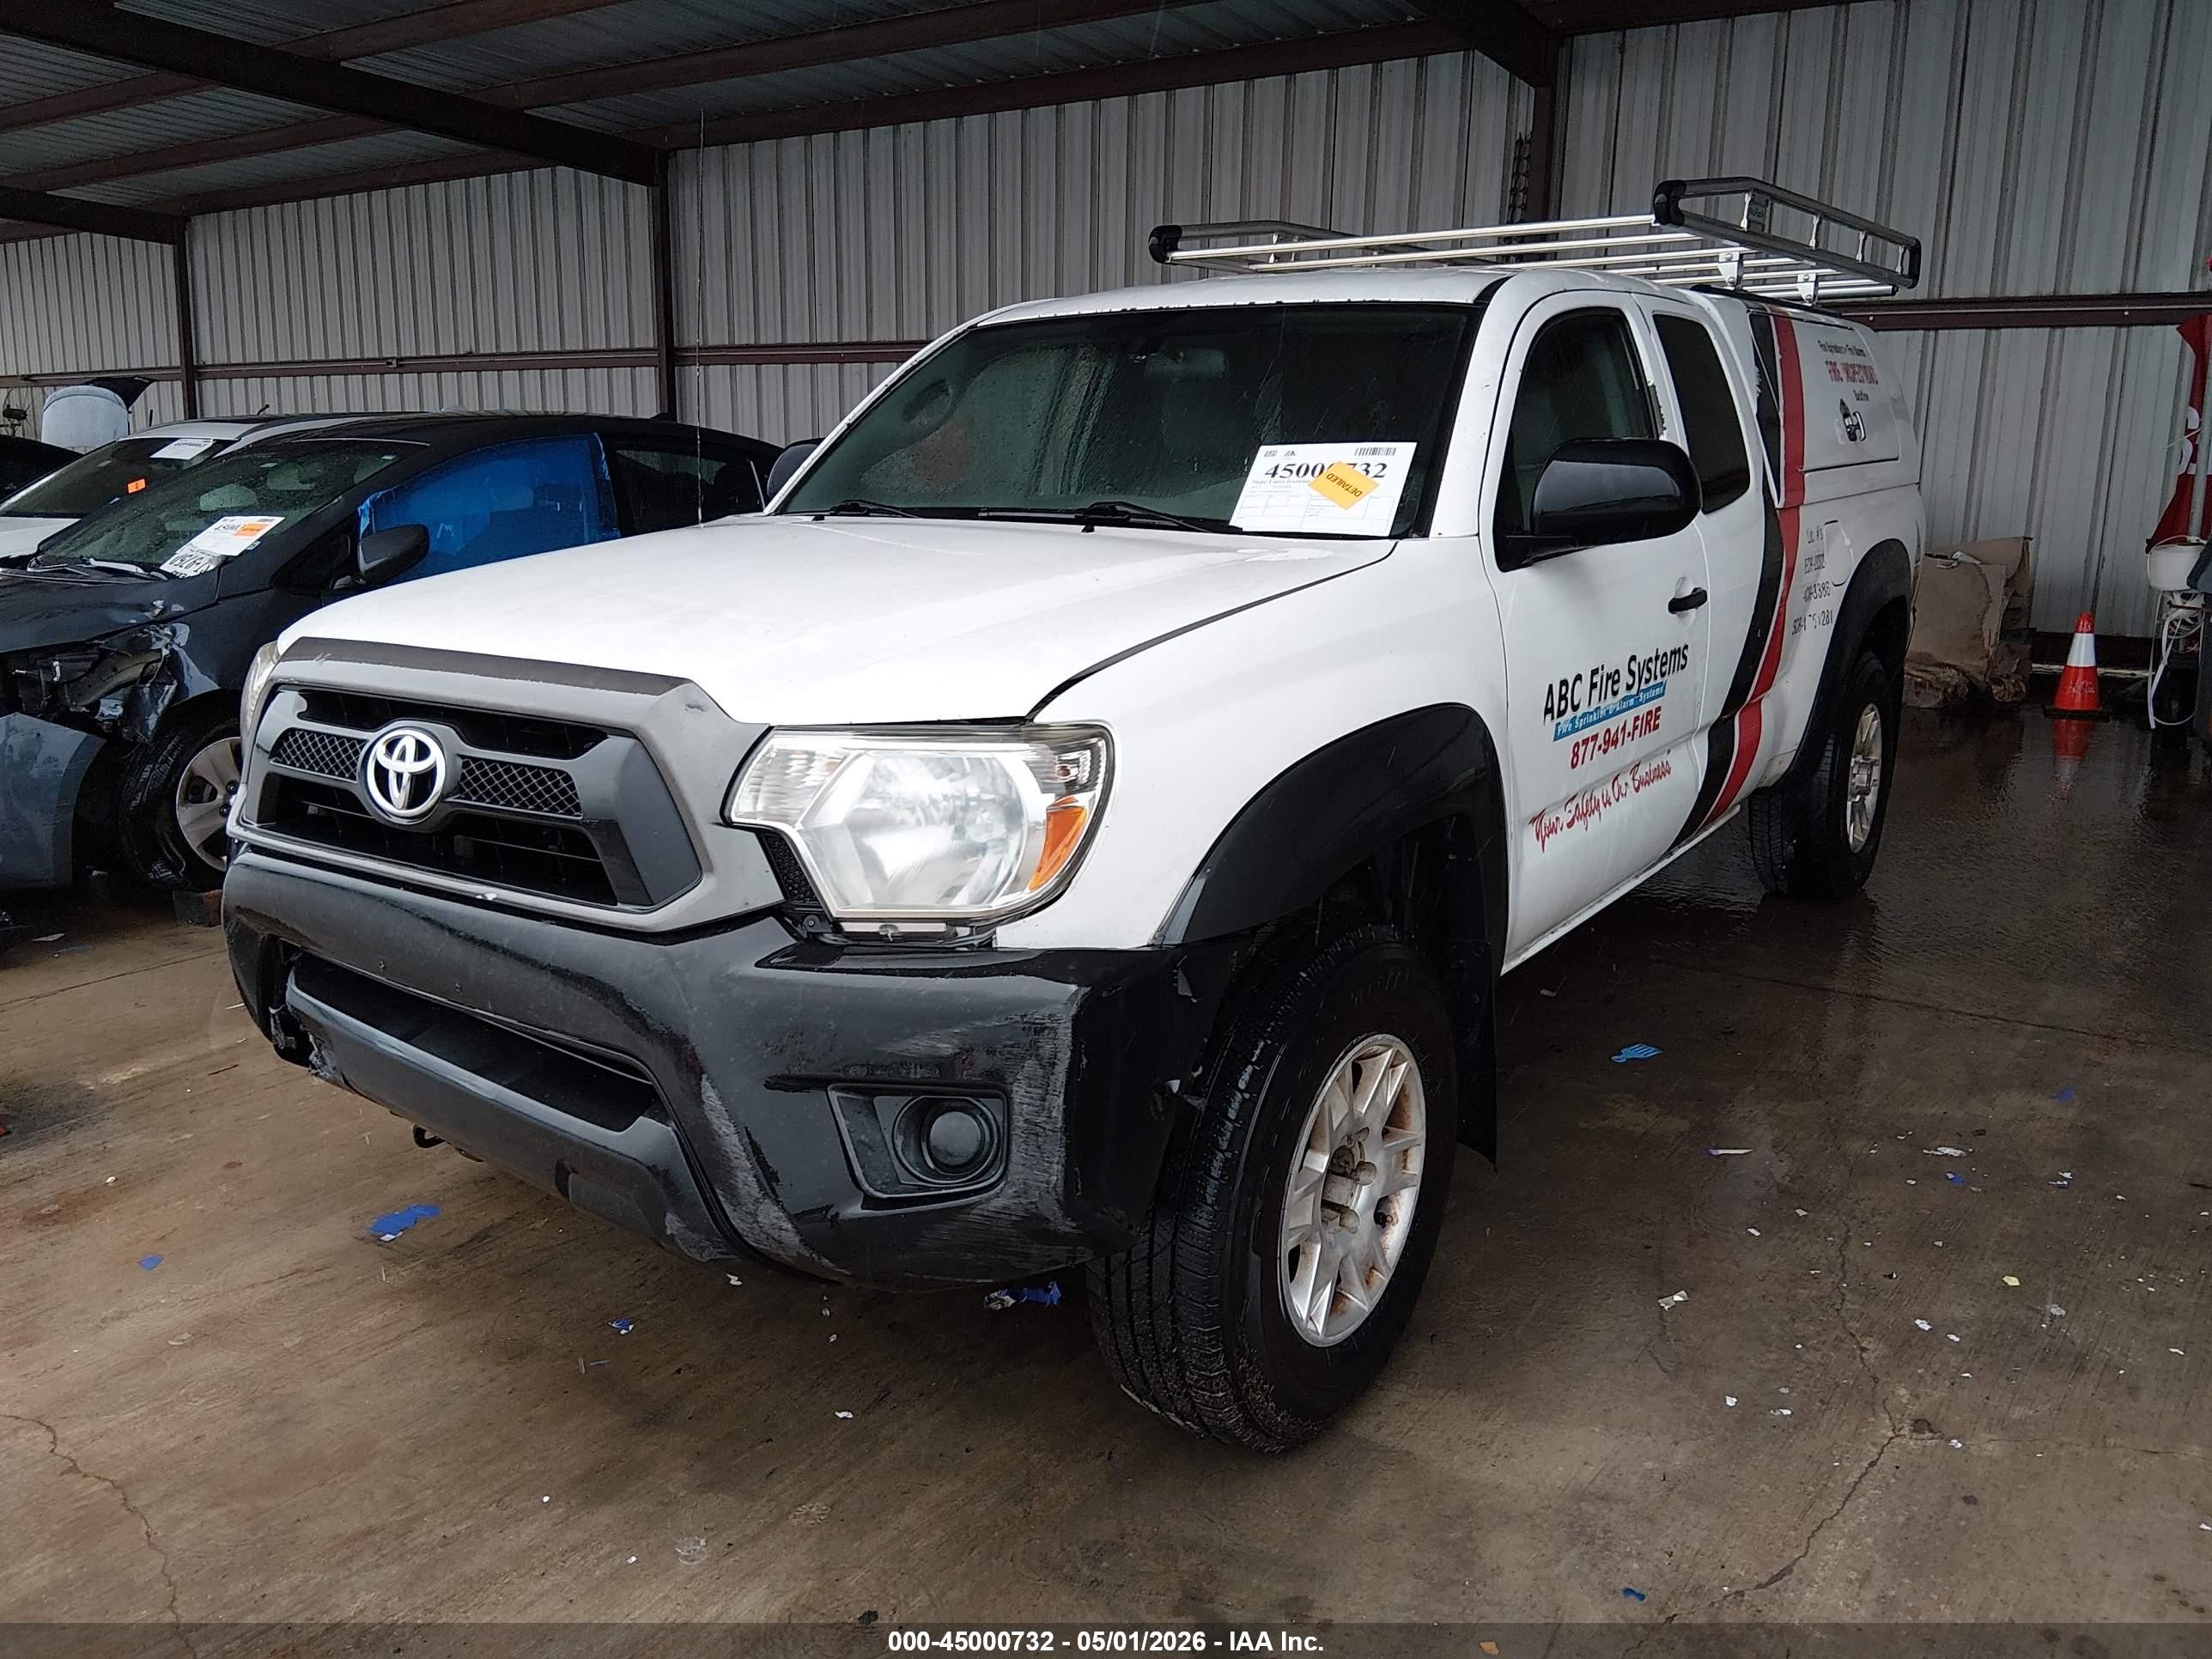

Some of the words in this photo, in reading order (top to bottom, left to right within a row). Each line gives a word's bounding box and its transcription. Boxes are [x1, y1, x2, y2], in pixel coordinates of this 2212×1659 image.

[1326, 473, 1363, 497] DETAILED
[1543, 672, 1583, 726] ABC
[1588, 664, 1621, 707] Fire
[1626, 643, 1689, 696] Systems
[1557, 720, 1572, 737] Fire
[1616, 698, 1635, 714] Alarm
[1638, 686, 1664, 702] Systems
[1571, 705, 1662, 770] 877-941-FIRE
[1565, 789, 1602, 832] Safety
